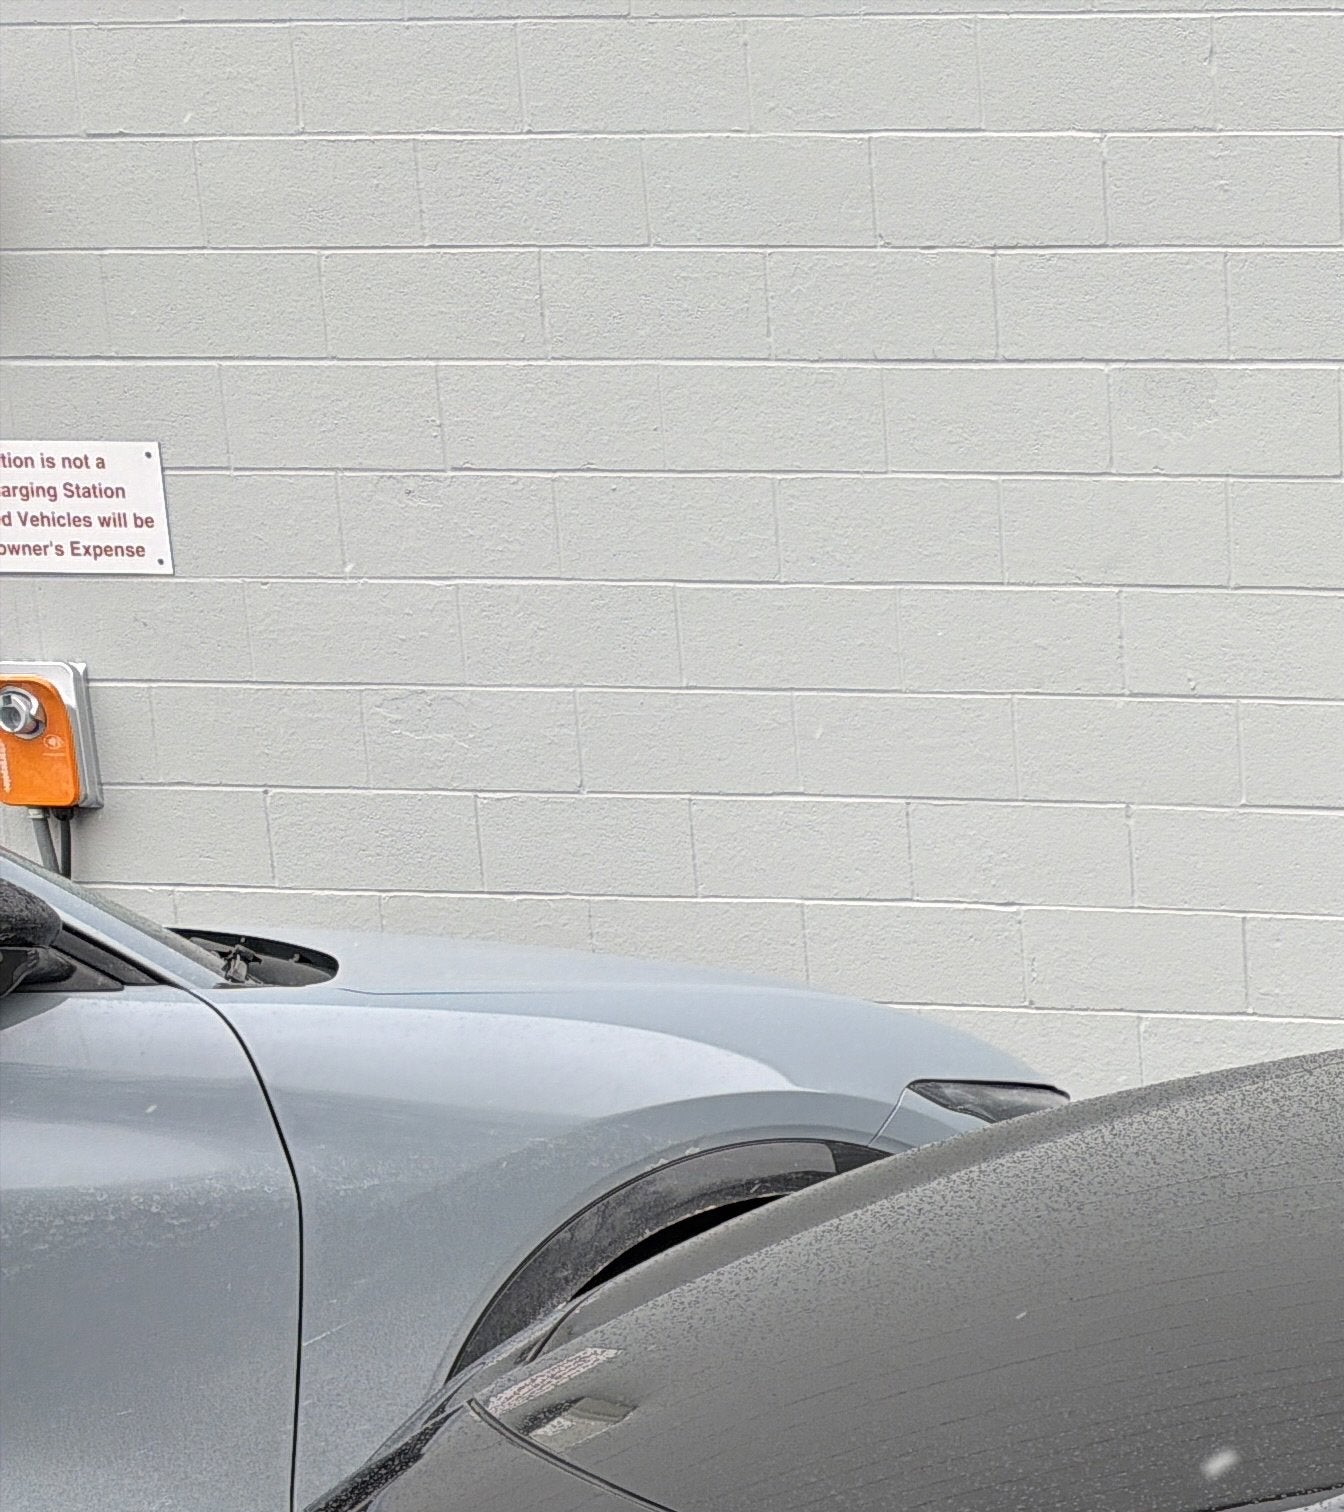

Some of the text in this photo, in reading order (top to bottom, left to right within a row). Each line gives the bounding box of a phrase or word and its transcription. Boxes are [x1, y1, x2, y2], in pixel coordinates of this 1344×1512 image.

[40, 452, 56, 469] is
[61, 454, 91, 469] not
[95, 456, 106, 469] a
[0, 481, 126, 502] arging Station
[0, 510, 155, 529] d Vehicles will be
[0, 539, 146, 560] owner's Expense
